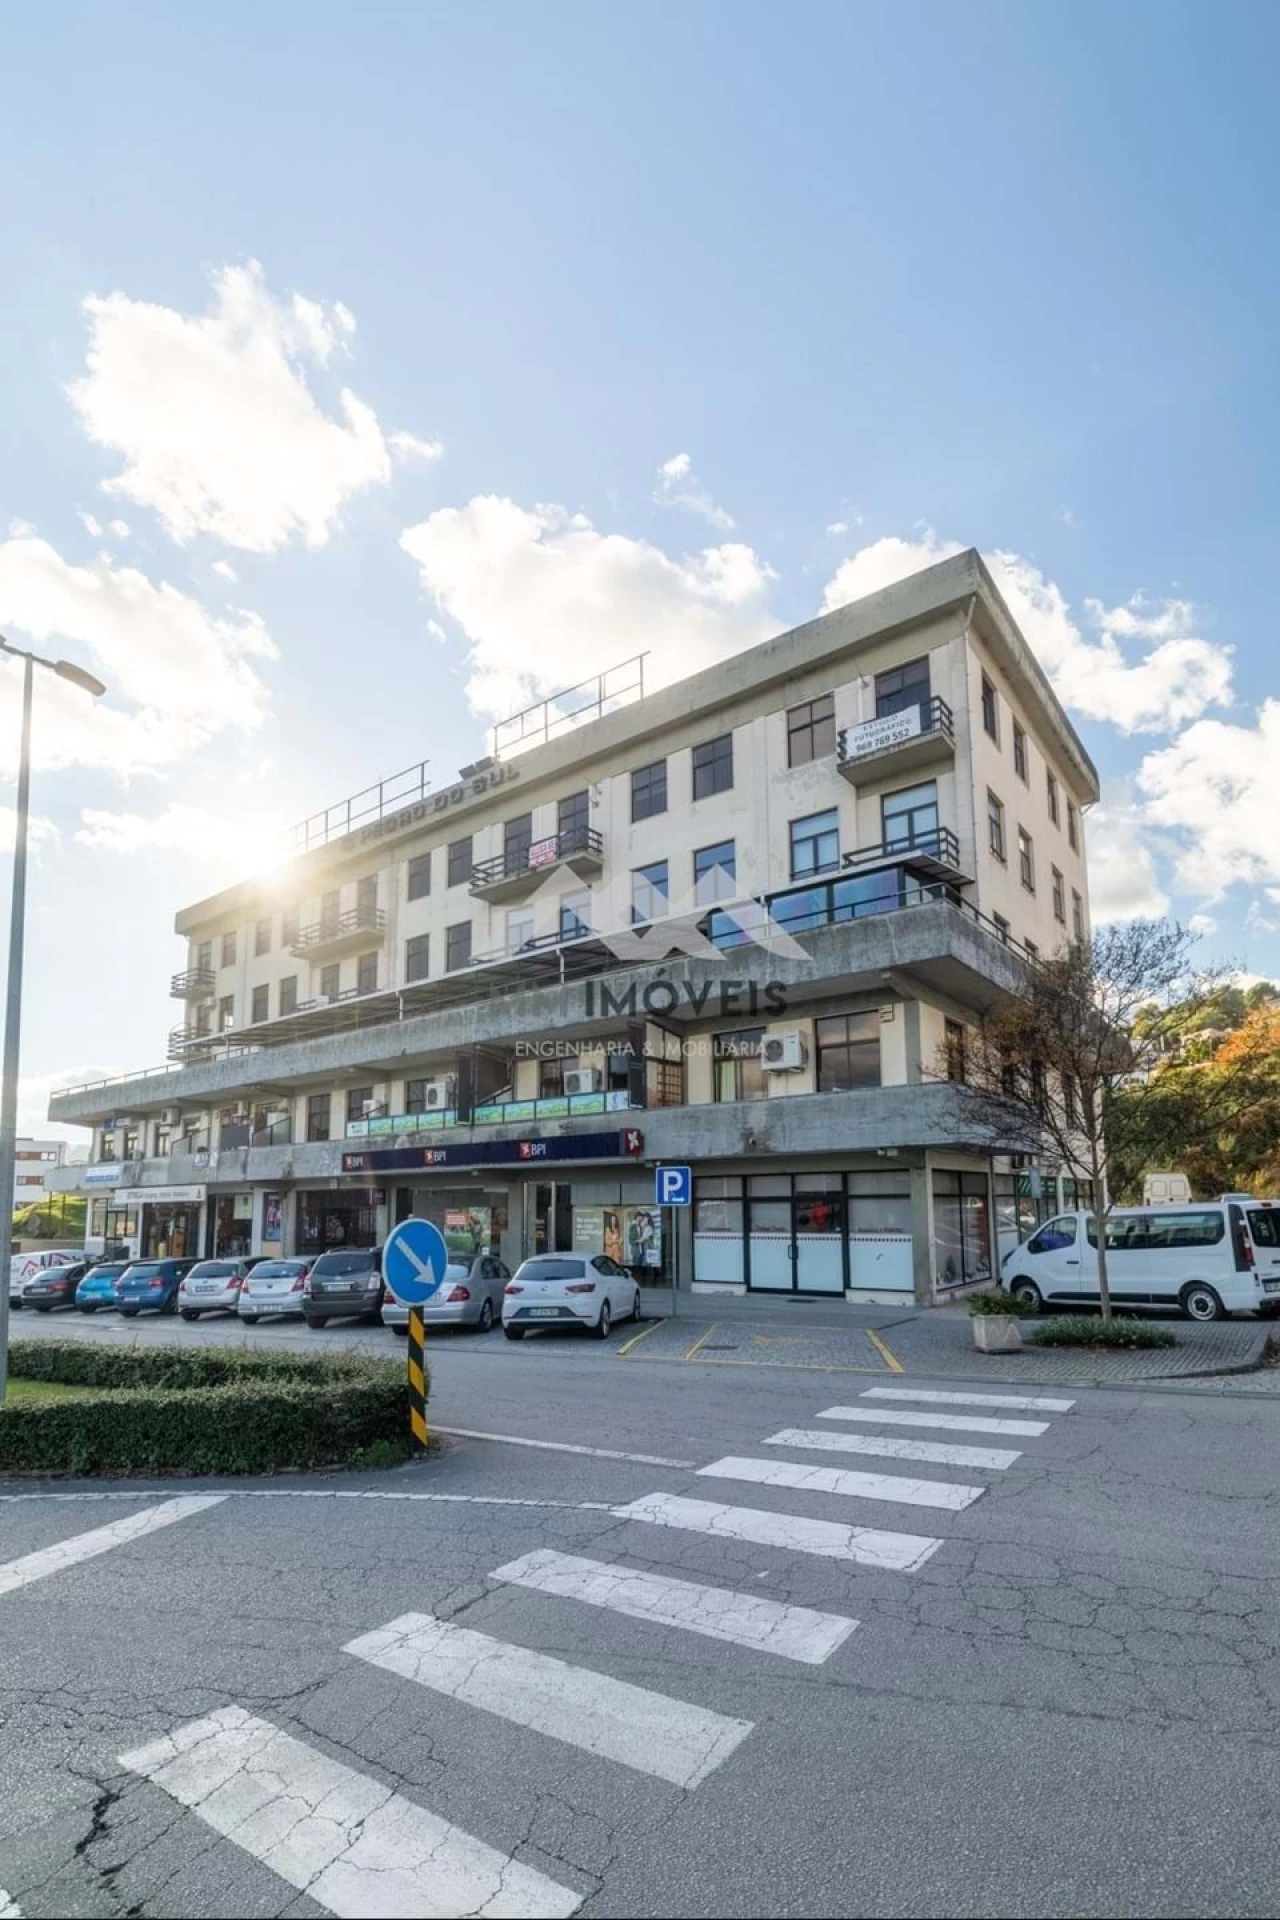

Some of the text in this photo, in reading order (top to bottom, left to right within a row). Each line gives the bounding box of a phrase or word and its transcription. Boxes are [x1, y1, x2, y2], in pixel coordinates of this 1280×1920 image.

[873, 734, 890, 746] 769
[892, 727, 909, 741] 552
[434, 786, 465, 812] DO
[472, 763, 521, 795] SUL
[433, 1150, 446, 1162] BPI
[531, 1142, 546, 1156] BPI
[352, 1156, 364, 1168] BPI
[663, 1170, 684, 1202] P
